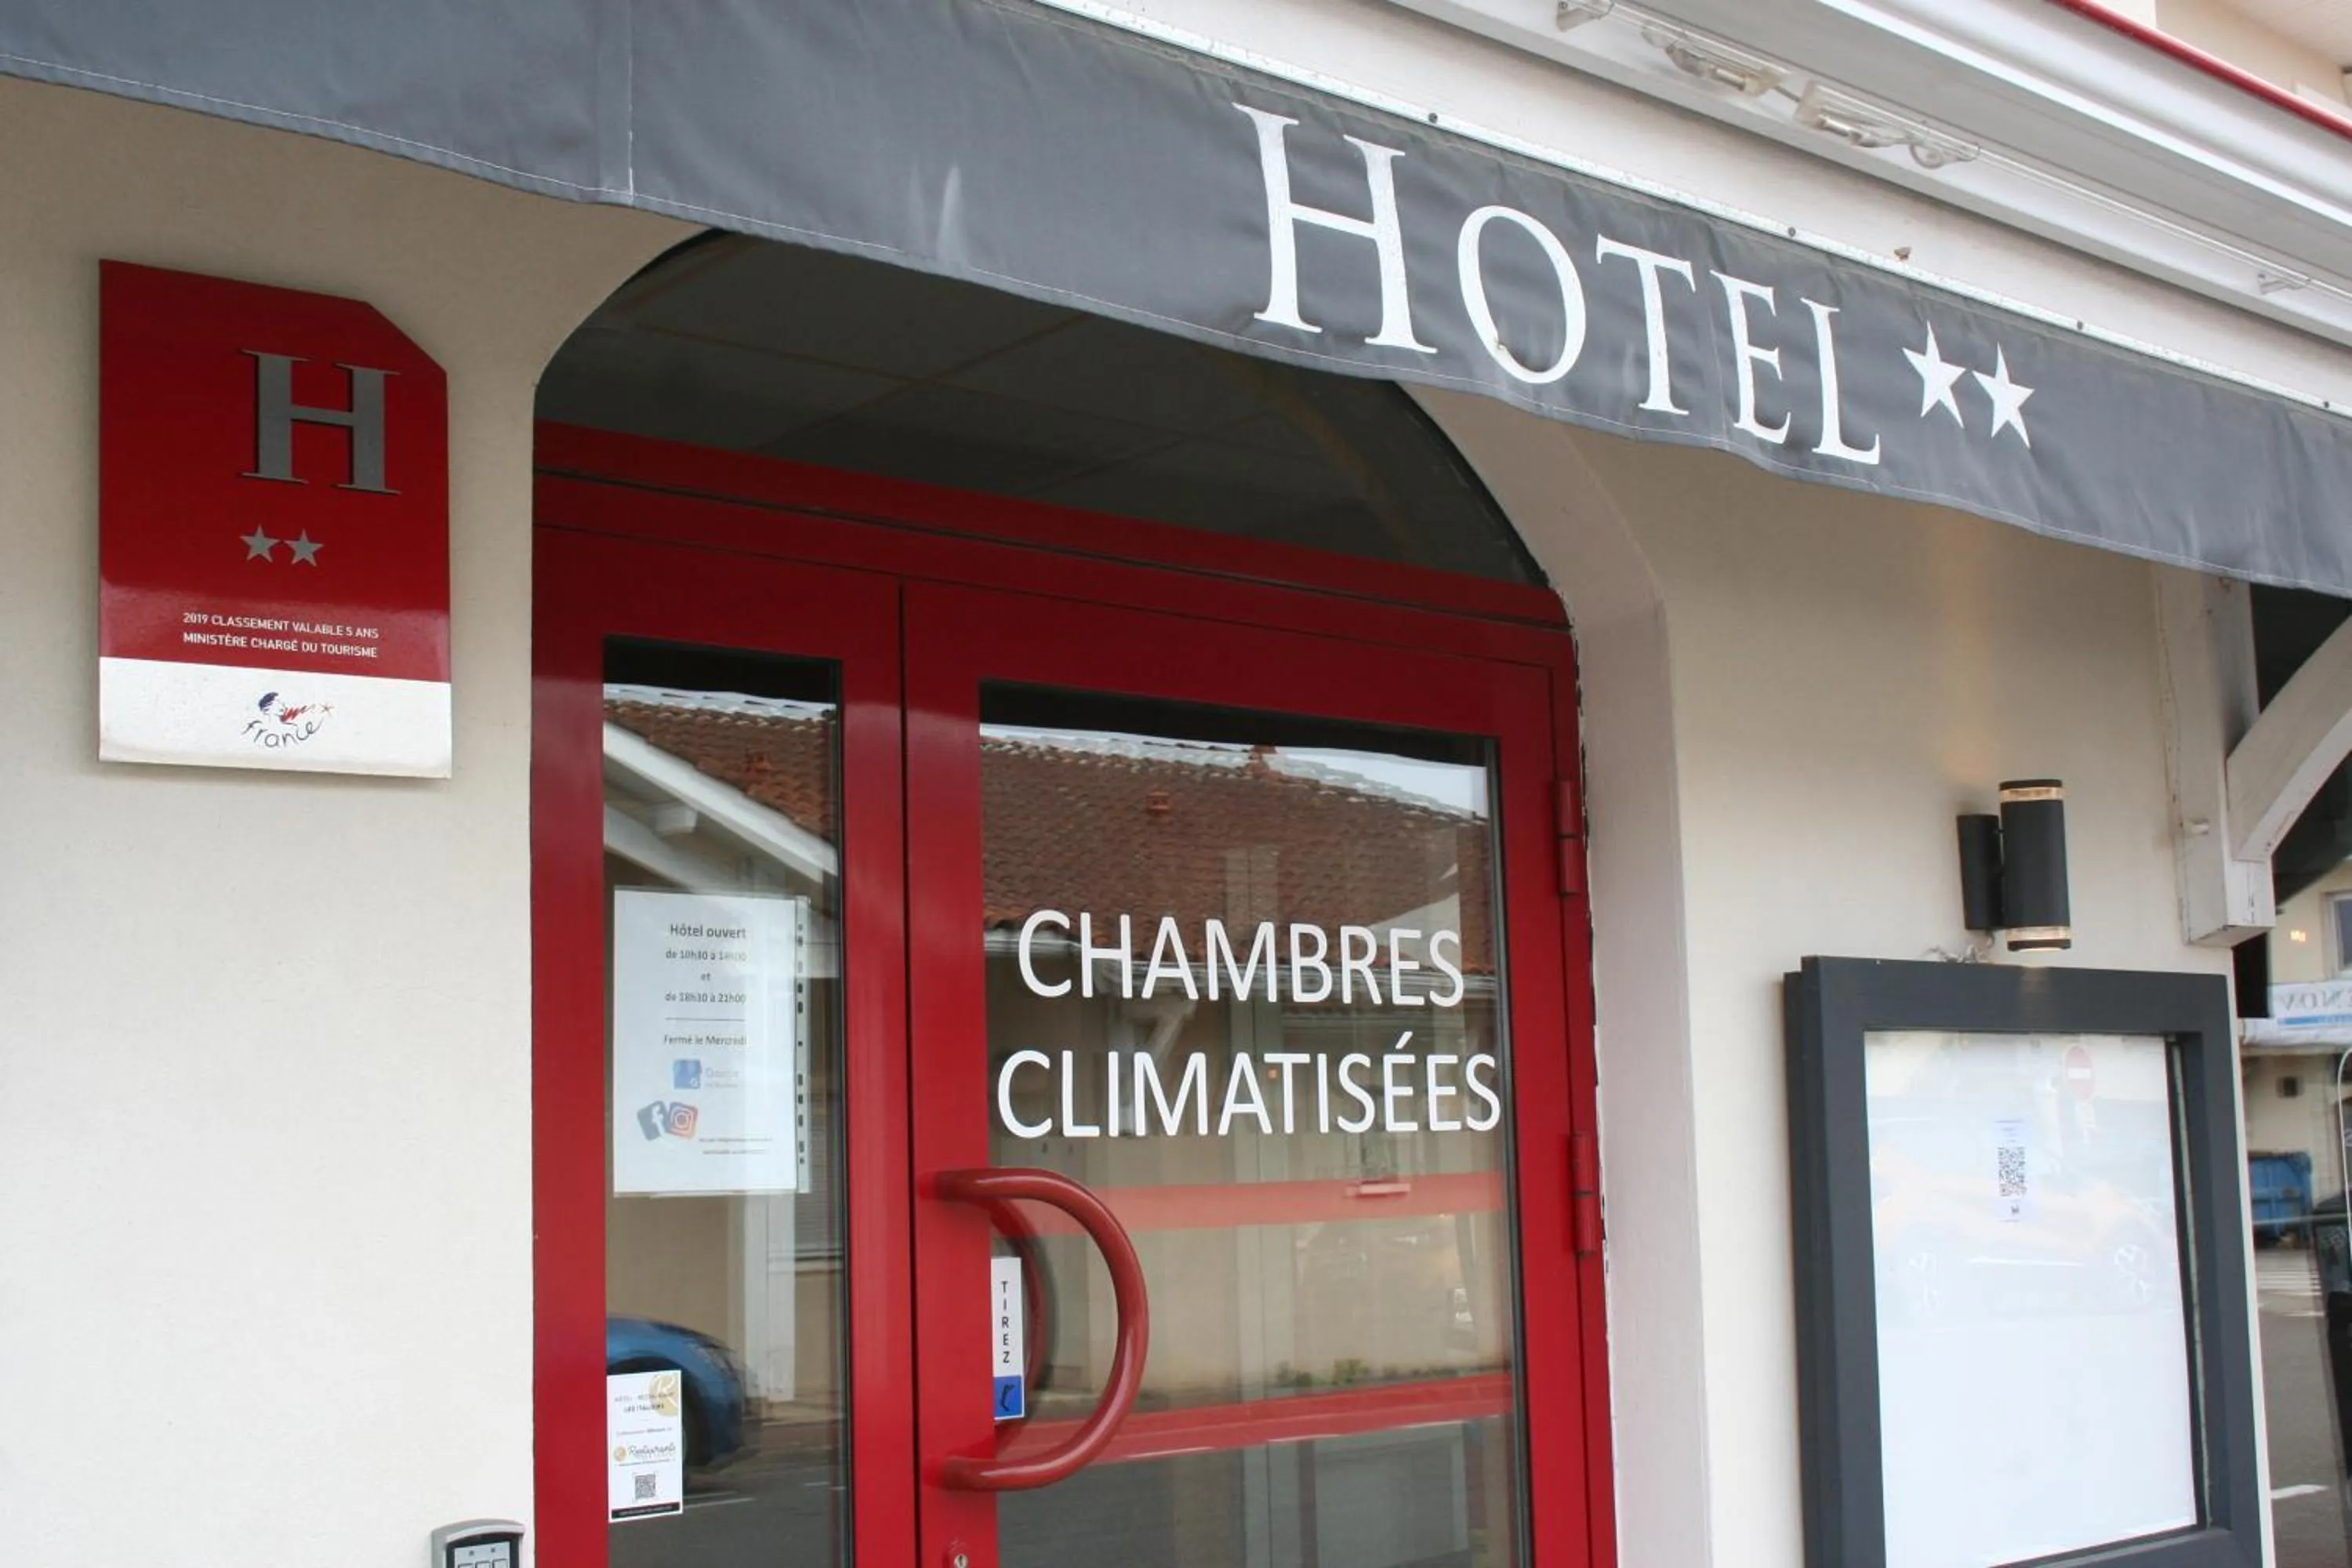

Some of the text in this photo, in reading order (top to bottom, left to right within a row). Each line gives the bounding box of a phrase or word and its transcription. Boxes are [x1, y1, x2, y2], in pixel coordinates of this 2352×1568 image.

[1231, 103, 1881, 465] HOTEL
[238, 350, 401, 495] H
[182, 612, 379, 639] 2019 CLASSEMENT VALABLE 5 ANS
[183, 632, 377, 658] MINISTÈRE CHARGÉ DU TOURISME
[670, 922, 746, 939] Hôtel ouvert
[666, 949, 677, 959] de
[1018, 909, 1464, 1007] CHAMBRES
[665, 992, 677, 1002] de
[664, 1034, 746, 1045] Fermé le Mercredi
[997, 1031, 1501, 1138] CLIMATISÉES
[1000, 1280, 1011, 1363] TIREZ
